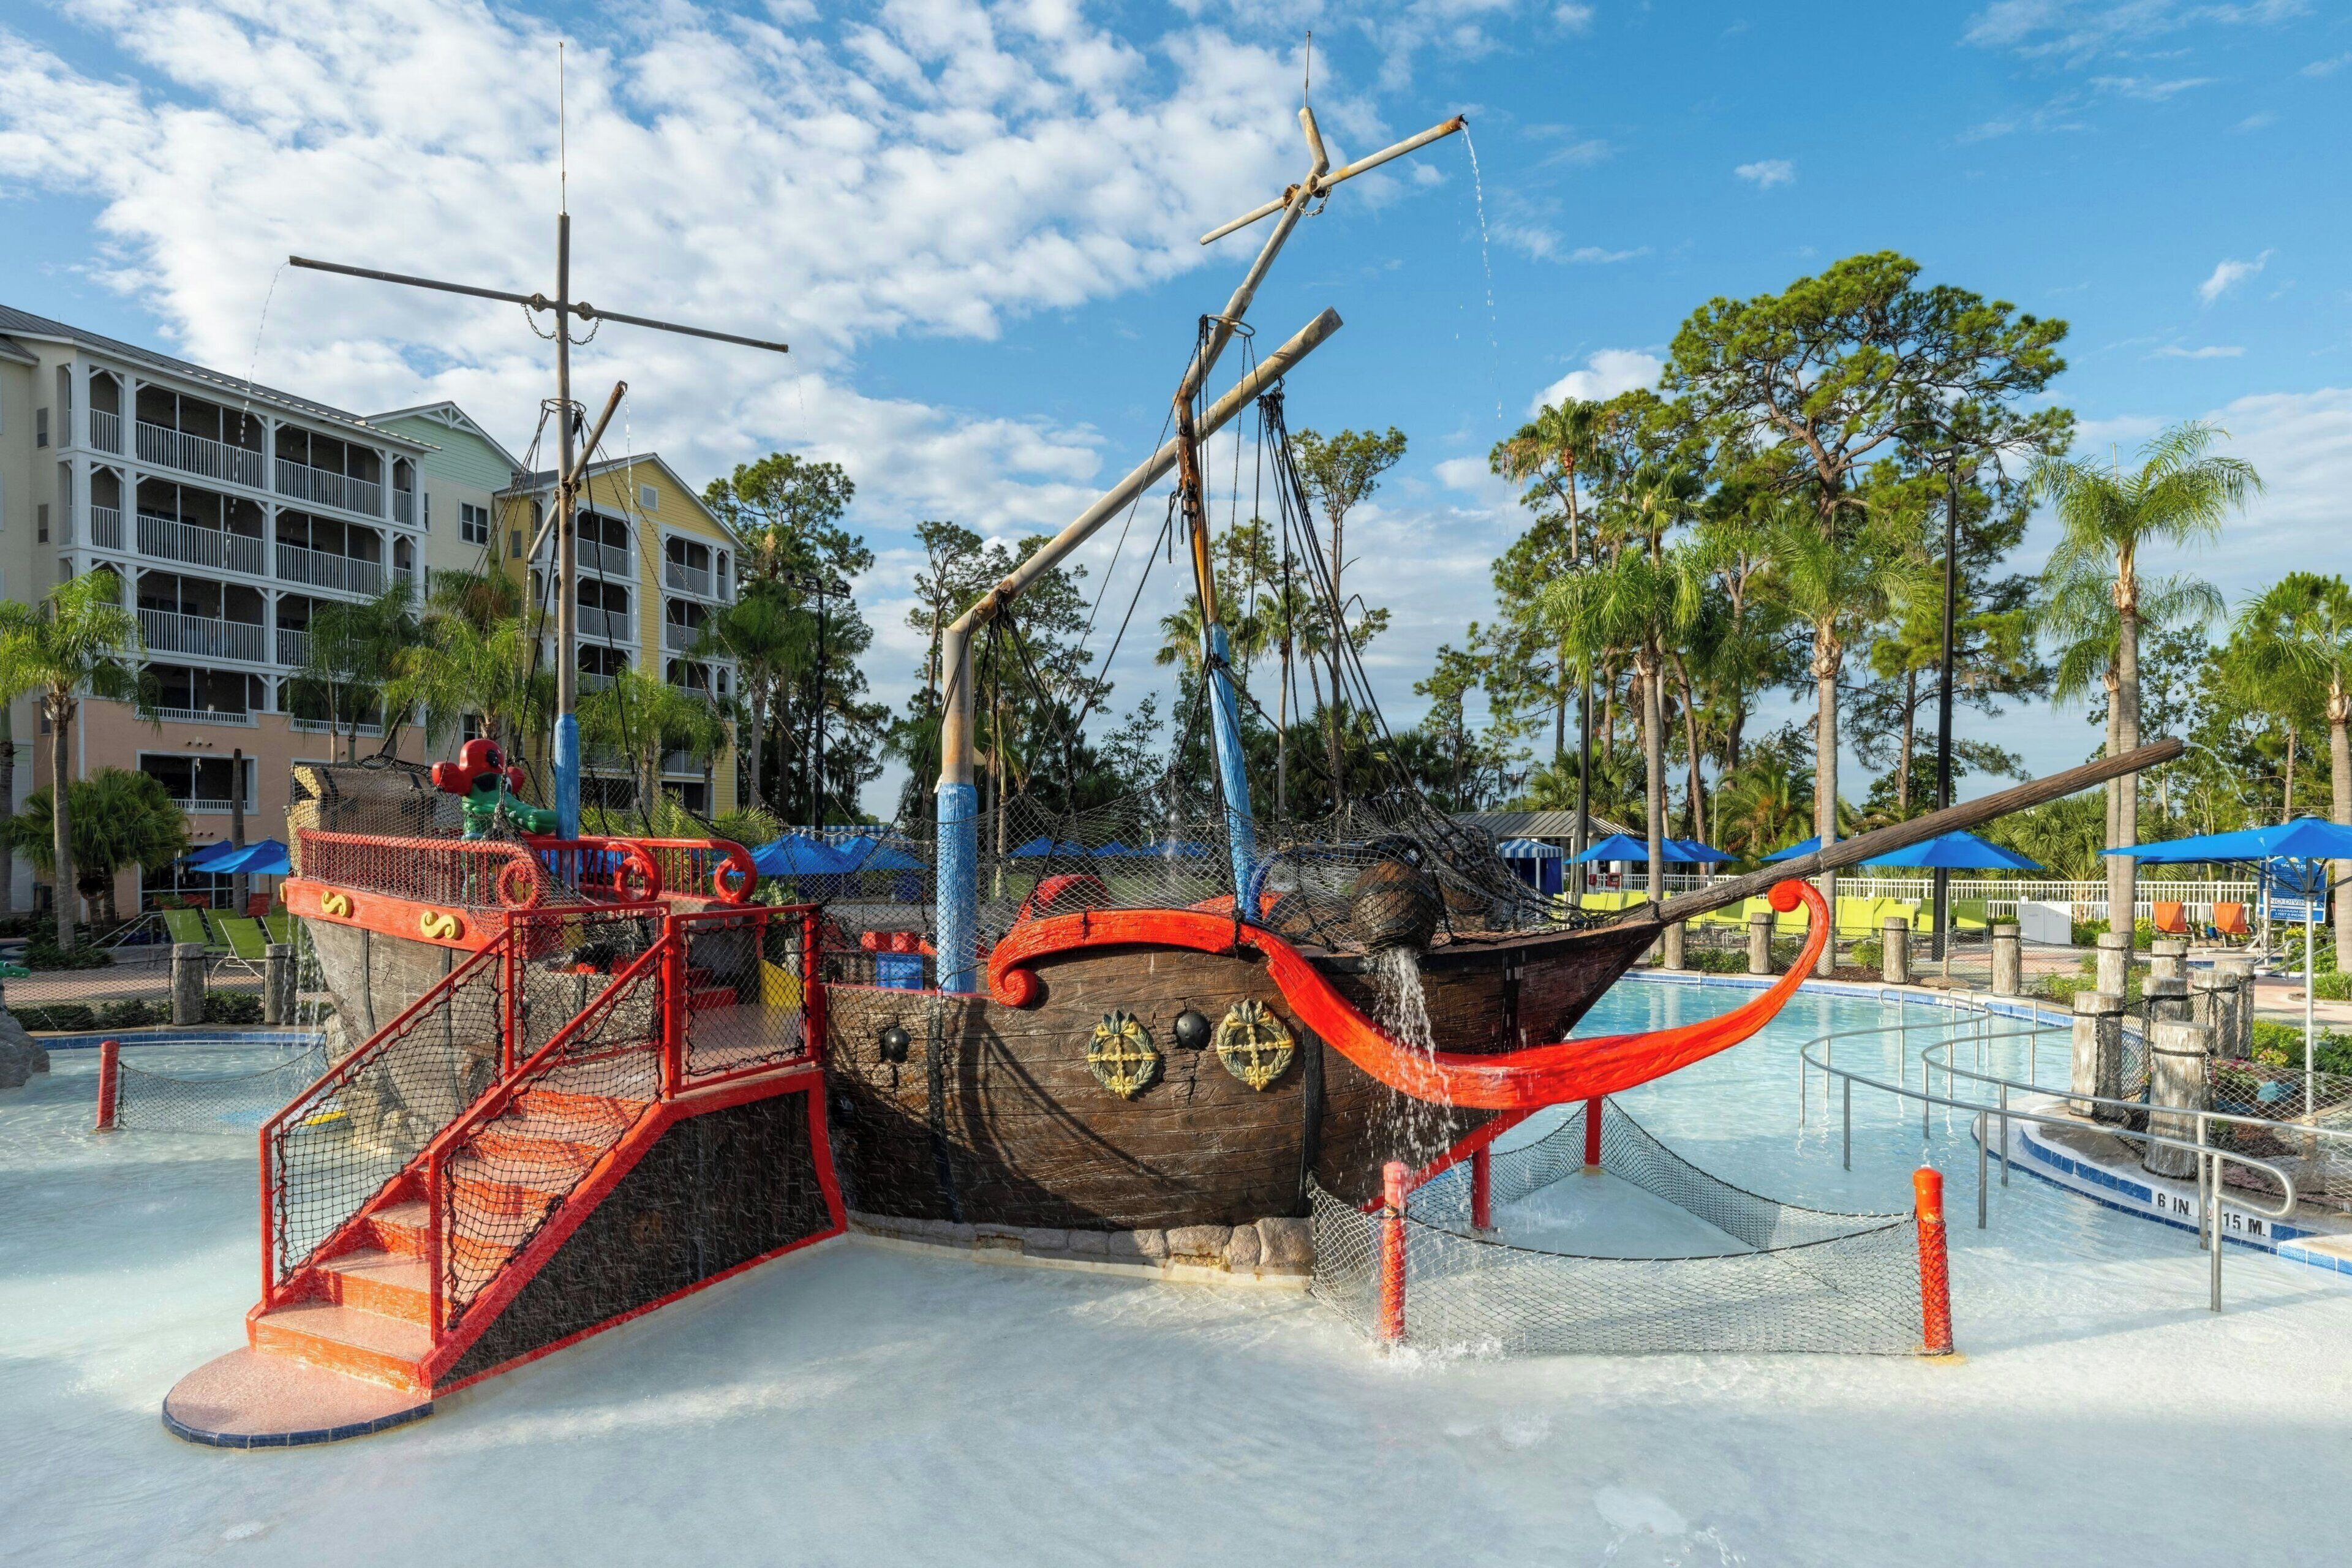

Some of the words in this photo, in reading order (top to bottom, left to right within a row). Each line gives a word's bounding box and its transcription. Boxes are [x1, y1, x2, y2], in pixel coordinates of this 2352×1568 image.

[2157, 1193, 2166, 1207] 6
[2173, 1197, 2192, 1216] IN.
[2248, 1218, 2266, 1237] M.
